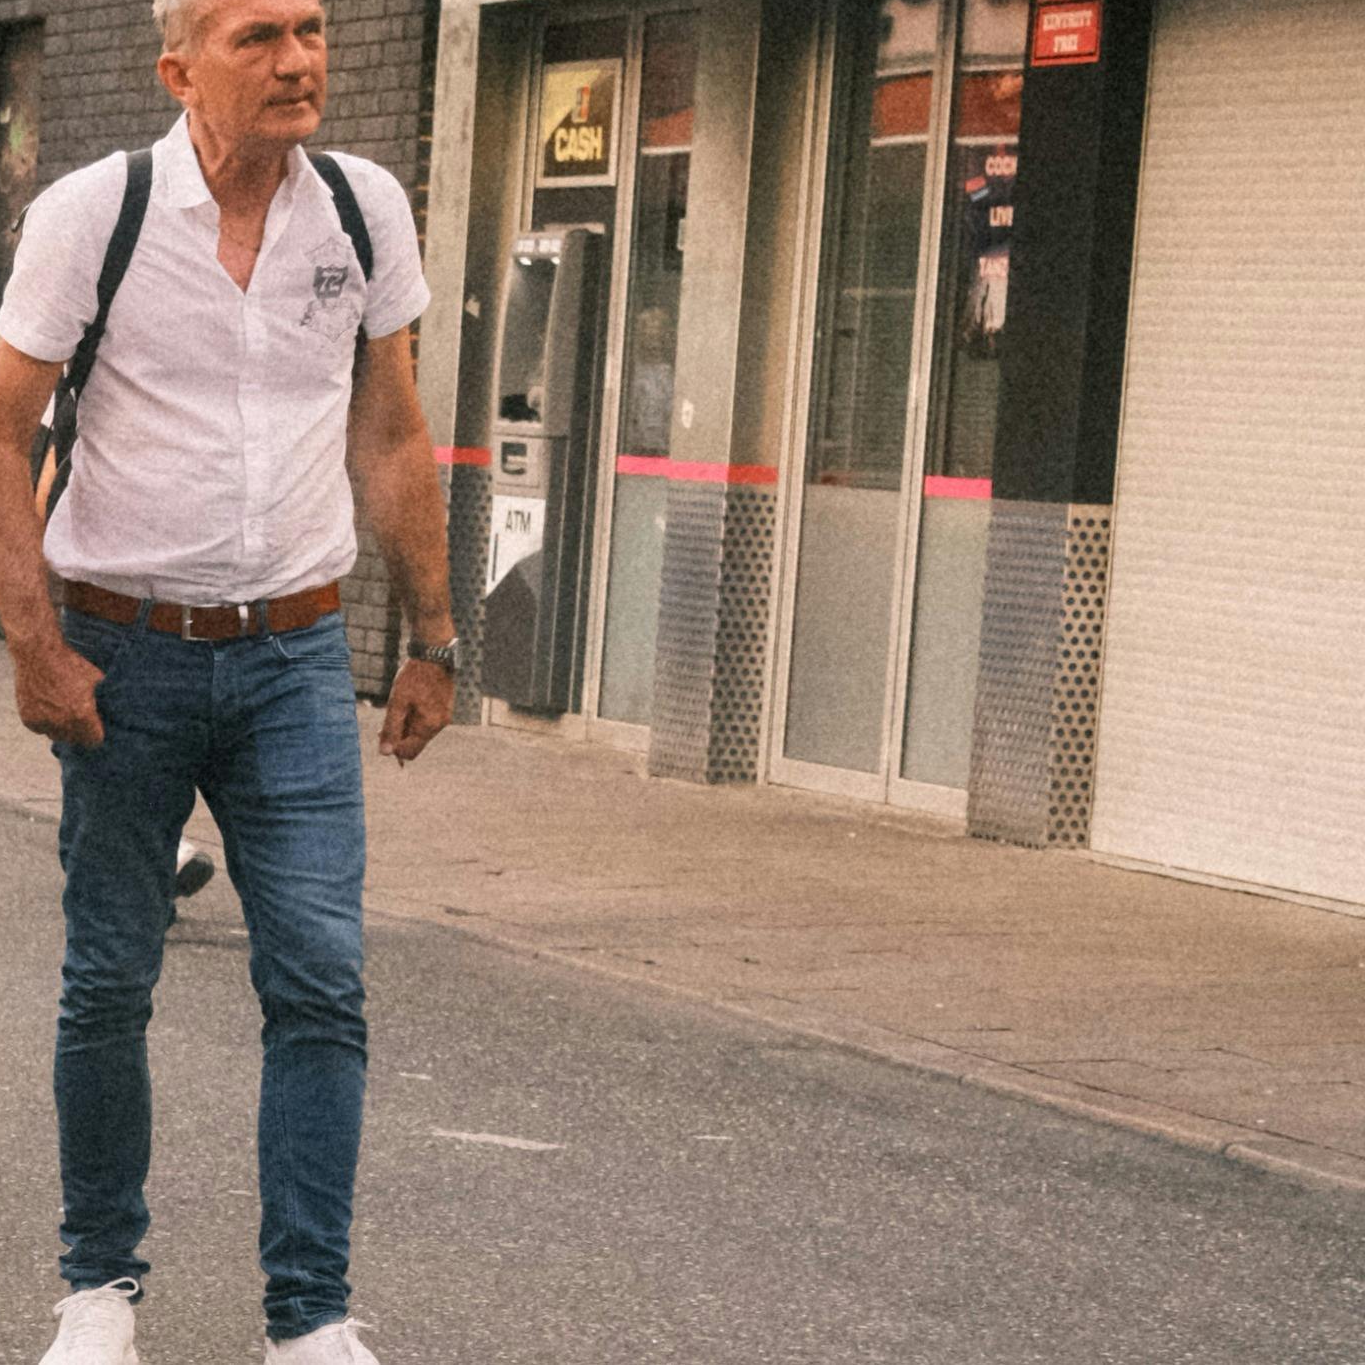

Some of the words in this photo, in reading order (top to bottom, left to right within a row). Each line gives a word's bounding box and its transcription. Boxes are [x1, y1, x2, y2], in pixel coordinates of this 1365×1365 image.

[553, 126, 604, 163] CASH
[318, 270, 345, 293] 72
[505, 509, 531, 533] ATM
